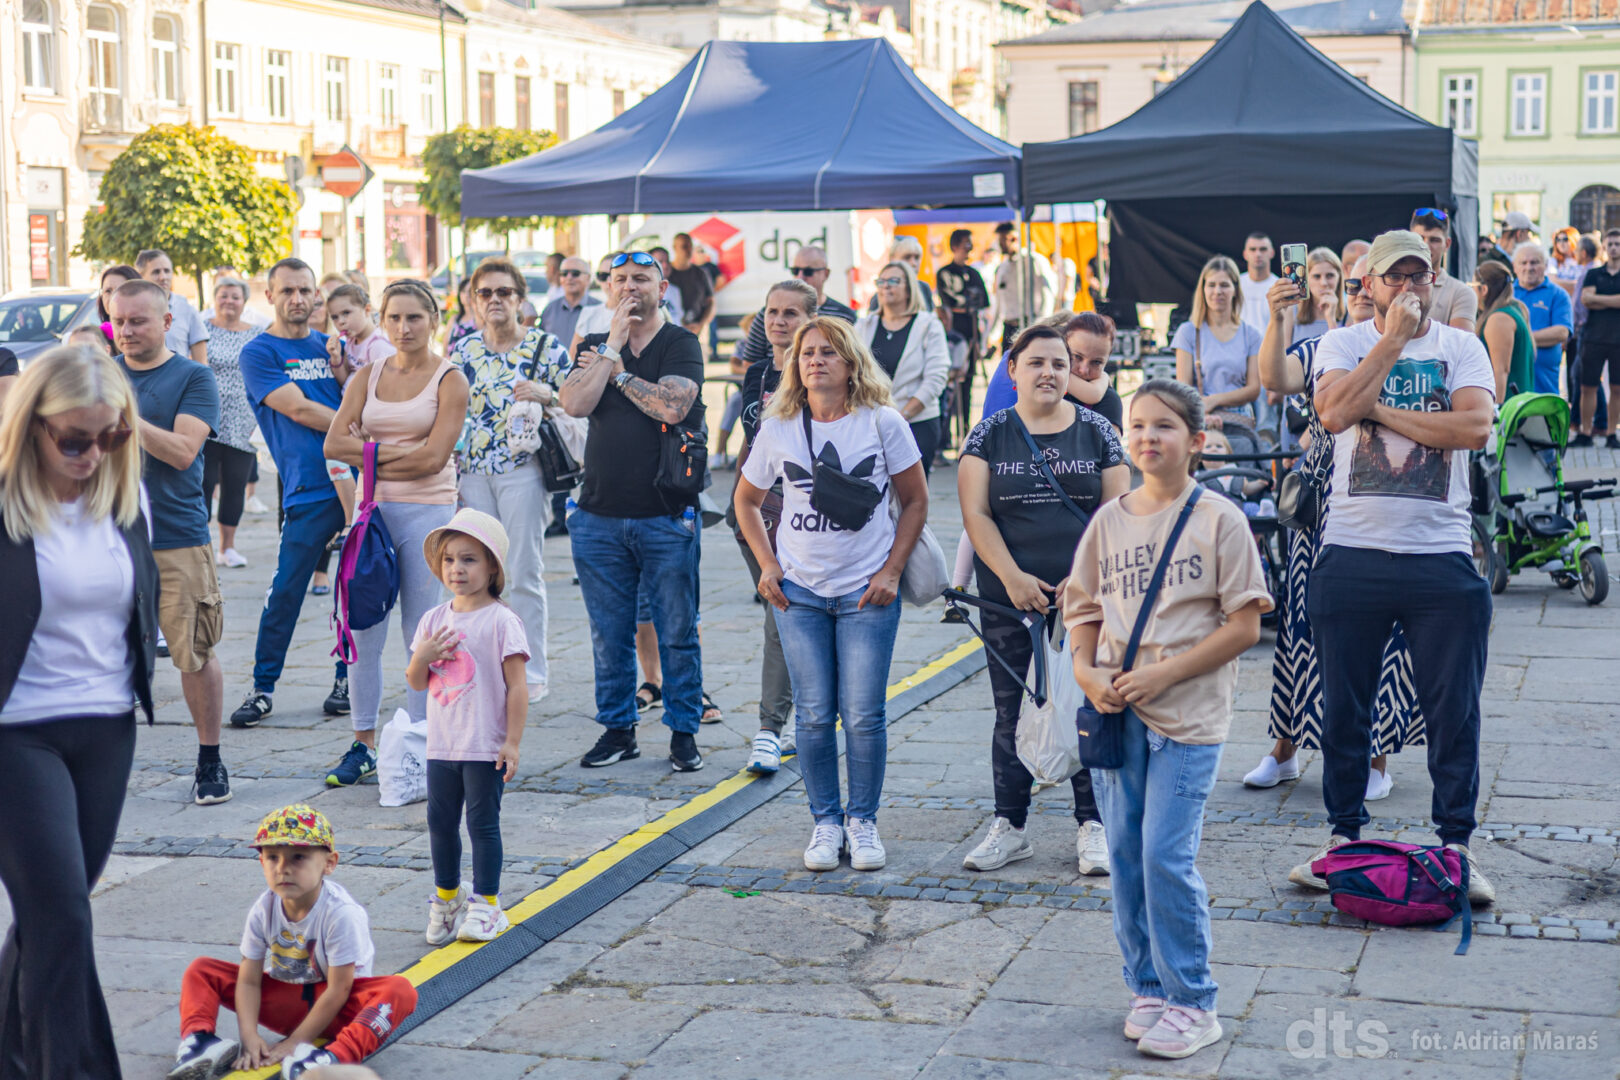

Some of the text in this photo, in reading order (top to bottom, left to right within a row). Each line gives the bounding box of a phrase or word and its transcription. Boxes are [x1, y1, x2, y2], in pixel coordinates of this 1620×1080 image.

[299, 358, 331, 370] DIVER
[996, 462, 1025, 476] THE
[790, 510, 862, 532] adi
[1123, 554, 1203, 600] HERTS
